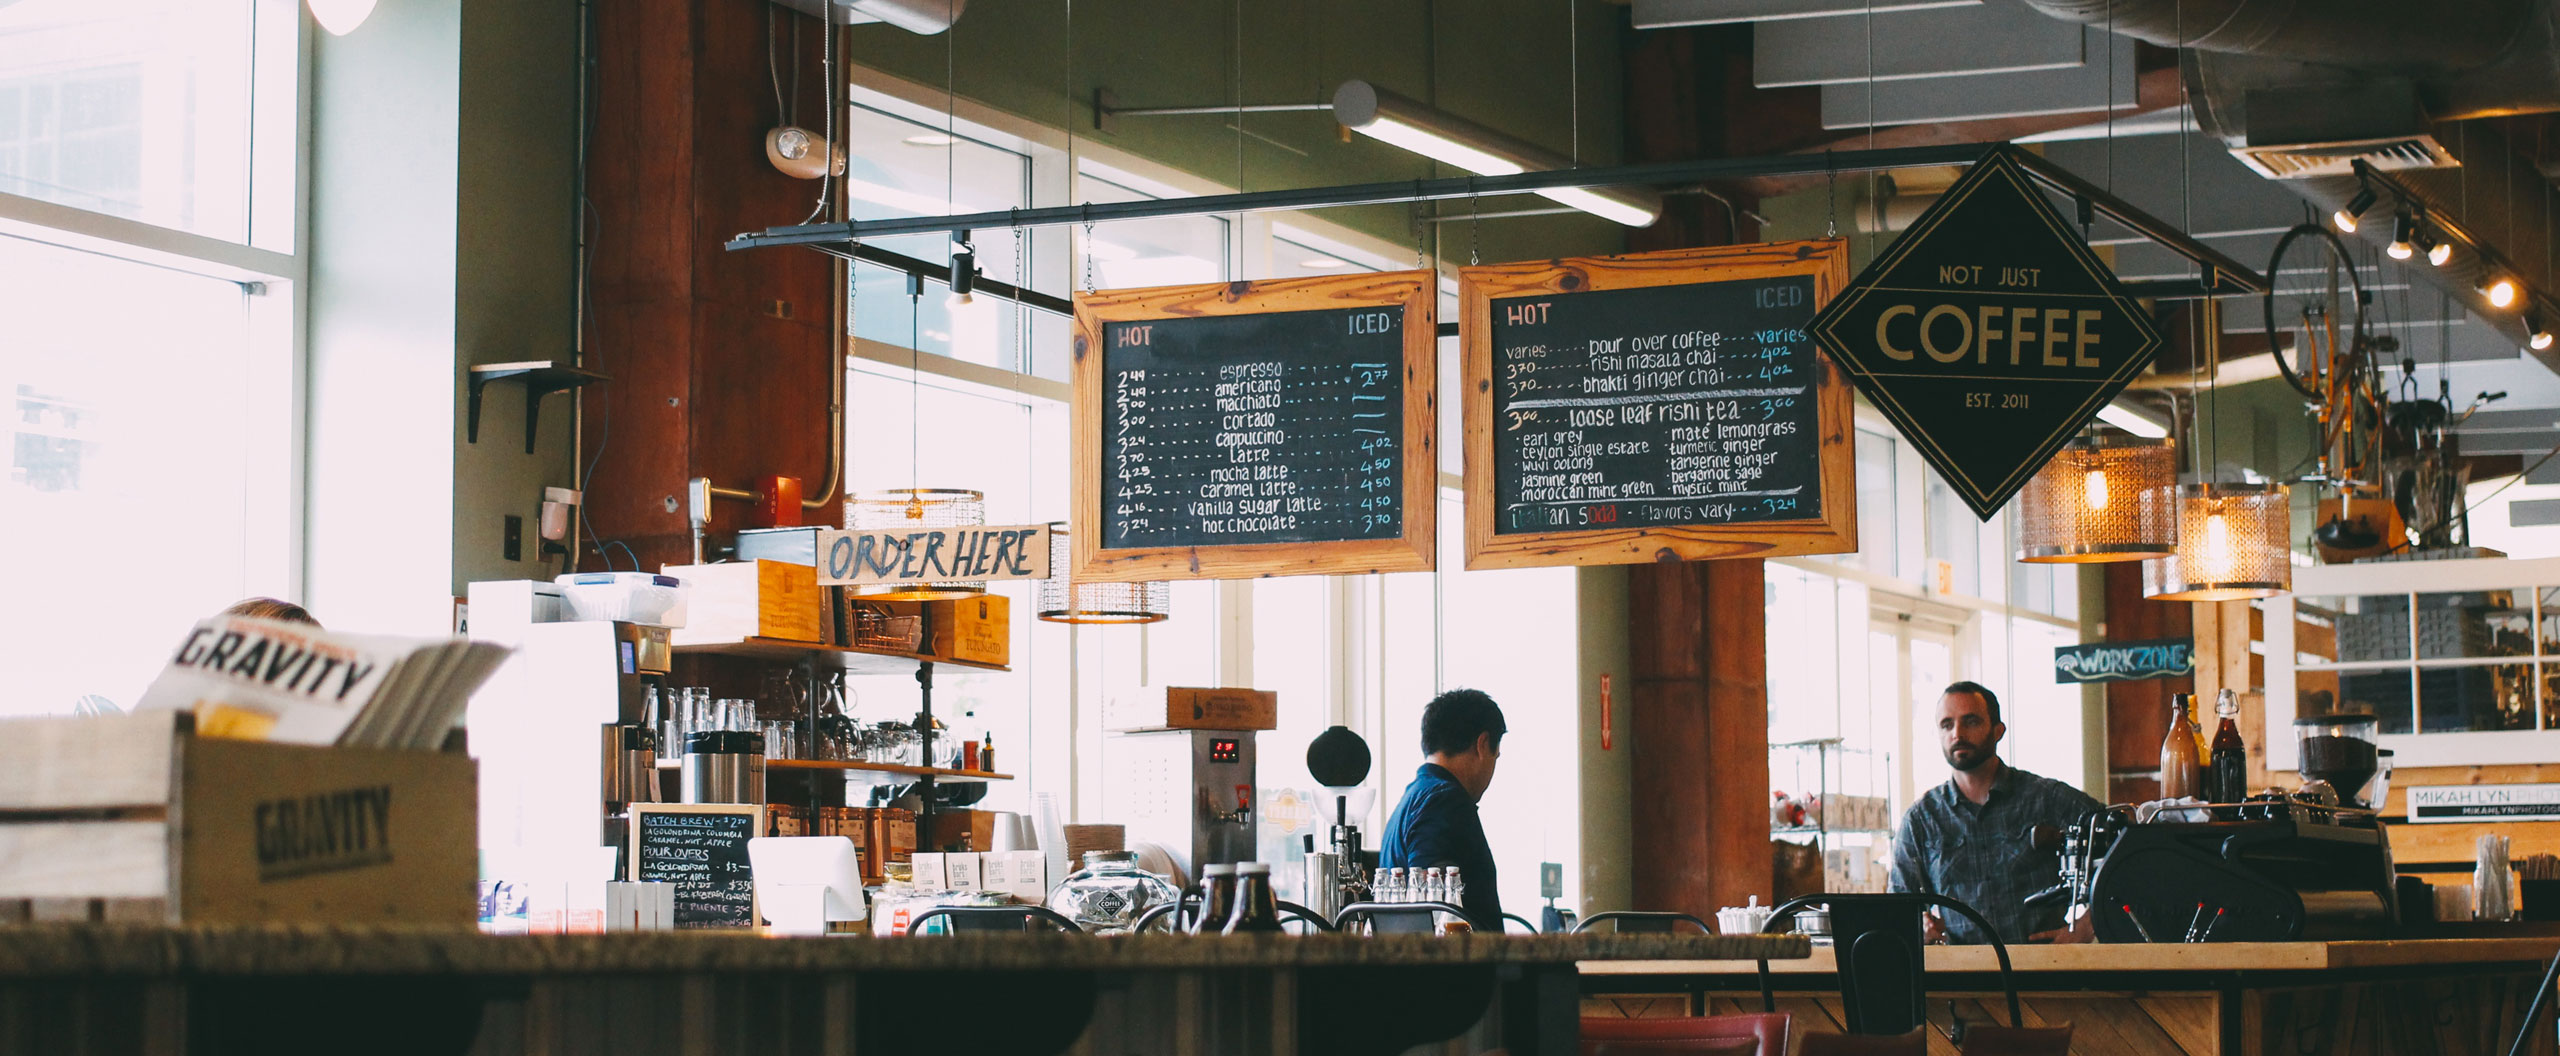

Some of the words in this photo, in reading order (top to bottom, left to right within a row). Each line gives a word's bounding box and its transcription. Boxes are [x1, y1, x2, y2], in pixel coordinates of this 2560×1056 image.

[1939, 265, 1983, 284] NOT
[1998, 268, 2041, 288] JUST
[1507, 303, 1551, 326] HOT
[1756, 286, 1802, 309] ICED
[1117, 326, 1153, 349] HOT
[1348, 313, 1390, 336] ICED
[1875, 304, 2102, 368] COFFEE
[1506, 345, 1546, 360] varies
[1589, 337, 1623, 358] pour
[1632, 335, 1667, 352] over
[1672, 330, 1721, 350] coffee
[1757, 328, 1807, 344] varies
[1507, 362, 1536, 379] 370
[1590, 354, 1622, 371] rishi
[1627, 352, 1680, 369] masala
[1686, 348, 1716, 366] chai
[1761, 346, 1792, 362] 402
[1117, 369, 1146, 390] 249
[1220, 361, 1282, 382] espresso
[1117, 386, 1146, 404] 249
[1215, 379, 1281, 397] americano
[1360, 369, 1389, 388] 277
[1508, 379, 1537, 397] 370
[1583, 375, 1627, 393] bhakti
[1632, 372, 1684, 391] ginger
[1689, 367, 1724, 384] chai
[1760, 365, 1792, 382] 402
[1118, 400, 1146, 420] 300
[1216, 394, 1281, 412] macchiato
[1965, 393, 1995, 409] EST.
[2001, 393, 2029, 409] 2011
[1118, 415, 1146, 436] 300
[1222, 411, 1276, 430] cortado
[1507, 410, 1538, 431] 300
[1570, 408, 1615, 428] loose
[1621, 404, 1654, 424] leaf
[1659, 401, 1700, 423] rishi
[1706, 400, 1740, 421] tea
[1760, 398, 1794, 420] 300
[1117, 435, 1146, 454] 324
[1215, 429, 1284, 450] cappuccino
[1523, 432, 1548, 446] earl
[1553, 430, 1583, 444] grey
[1717, 421, 1796, 440] lemongrass
[1117, 452, 1145, 470] 370
[1229, 446, 1270, 464] latte
[1360, 438, 1392, 456] 402
[1522, 446, 1563, 461] ceylon
[1567, 444, 1603, 458] single
[1607, 441, 1650, 455] estate
[1669, 441, 1717, 455] turmeric
[1722, 438, 1766, 454] ginger
[1118, 466, 1150, 482] 425
[1210, 464, 1250, 482] mocha
[1254, 464, 1289, 481] latte
[1360, 458, 1391, 475] 450
[1553, 457, 1594, 471] oolong
[1670, 455, 1730, 471] tangerine
[1734, 451, 1778, 468] ginger
[1521, 473, 1566, 490] jasmine
[1569, 471, 1604, 487] green
[1672, 468, 1731, 484] bergamot
[1734, 466, 1763, 482] sage
[1118, 483, 1153, 500] 425
[1200, 482, 1254, 499] caramel
[1259, 480, 1297, 496] latte
[1360, 476, 1391, 493] 450
[1521, 485, 1584, 502] moroccan
[1587, 484, 1617, 500] mint
[1621, 480, 1655, 498] green
[1672, 482, 1713, 498] mystic
[1718, 480, 1748, 493] mint
[1117, 502, 1146, 517] 416
[1188, 500, 1233, 516] vanilla
[1238, 498, 1281, 516] sugar
[1286, 496, 1322, 511] latte
[1360, 495, 1391, 512] 450
[1512, 506, 1569, 528] italian
[1578, 504, 1617, 526] soda
[1641, 503, 1693, 521] flavors
[1699, 502, 1733, 522] vary
[1763, 497, 1796, 515] 324
[1118, 518, 1149, 539] 324
[1202, 517, 1225, 533] hot
[1227, 514, 1297, 532] chocolate
[1361, 514, 1391, 533] 370
[829, 531, 949, 580] ORDER
[949, 528, 1039, 577] HERE
[175, 625, 375, 702] GRAVITY
[2415, 790, 2472, 805] MIKAH
[2477, 789, 2511, 804] LYN
[256, 783, 392, 866] GRAVITY
[643, 815, 677, 826] BATCH
[680, 816, 715, 827] BREW
[643, 845, 672, 858] POUR
[674, 848, 709, 861] OVERS
[690, 902, 729, 914] PUENTE
